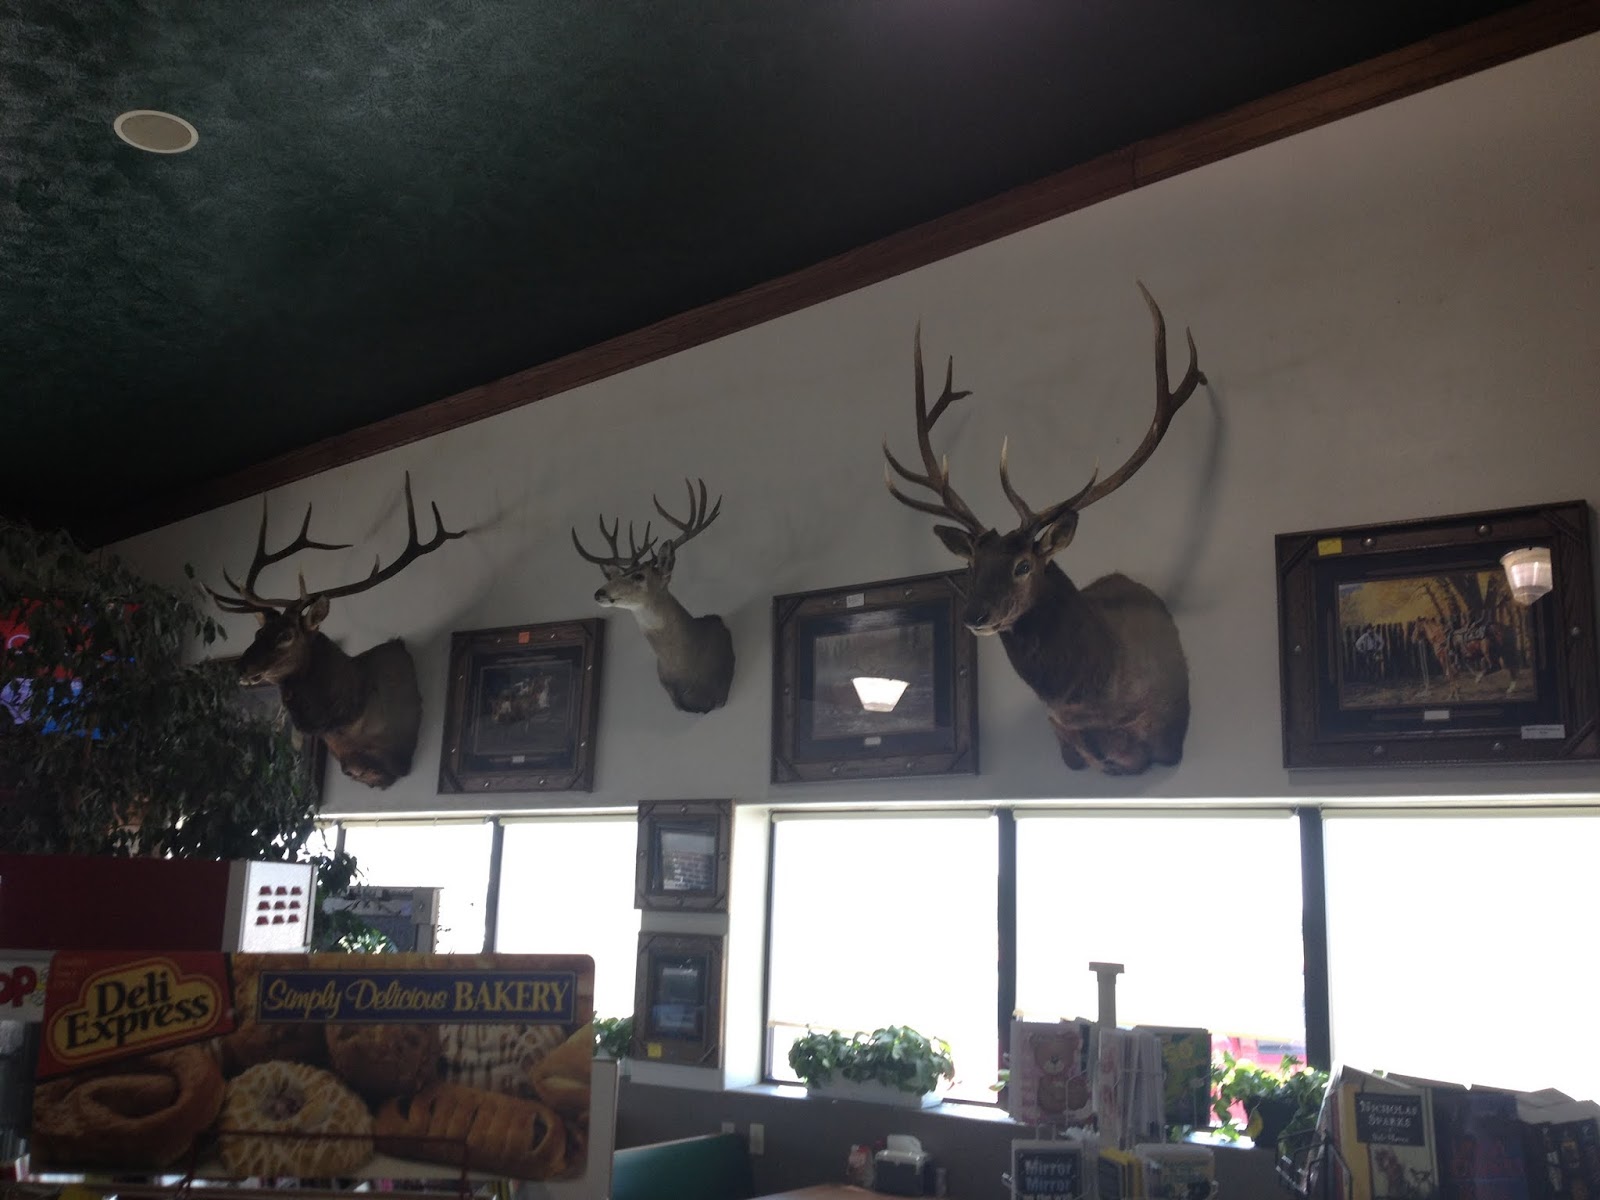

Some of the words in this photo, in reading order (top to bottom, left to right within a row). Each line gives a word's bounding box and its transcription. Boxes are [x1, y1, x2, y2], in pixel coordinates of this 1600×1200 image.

[95, 971, 172, 1018] Deli
[263, 979, 343, 1020] Simply
[344, 978, 449, 1011] Delicious
[453, 979, 569, 1012] BAKERY
[66, 993, 210, 1050] Express
